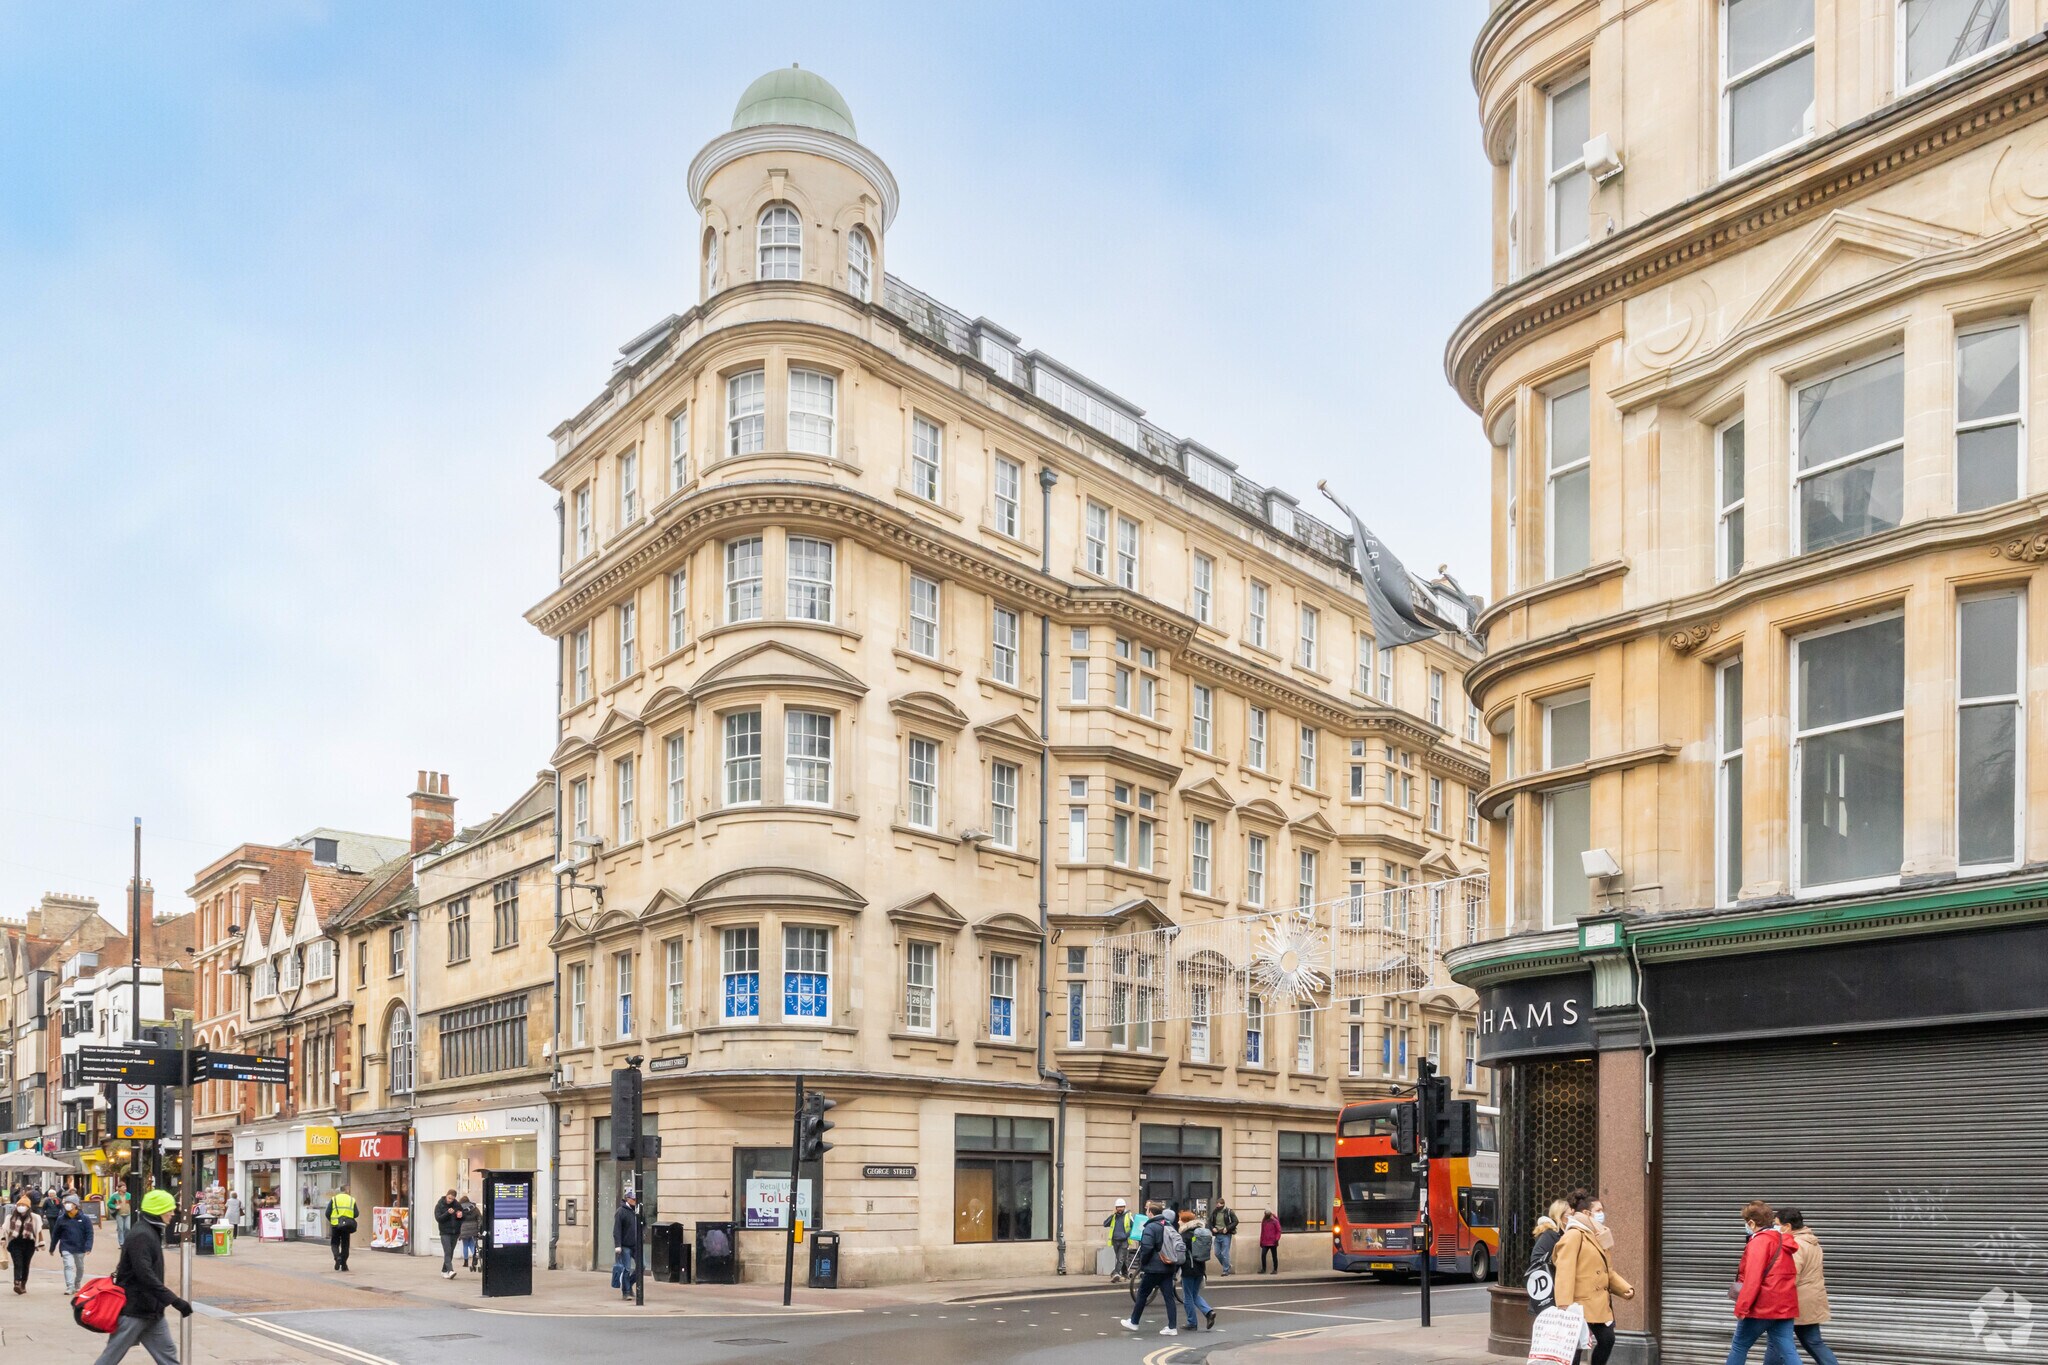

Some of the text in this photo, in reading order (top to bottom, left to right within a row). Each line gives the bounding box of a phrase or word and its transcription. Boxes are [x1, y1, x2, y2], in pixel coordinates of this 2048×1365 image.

[311, 1134, 332, 1145] itsu
[359, 1138, 381, 1158] KFC
[1374, 1161, 1389, 1173] S3
[760, 1182, 780, 1190] Retail
[760, 1193, 791, 1203] To Le
[1533, 1275, 1548, 1296] JD
